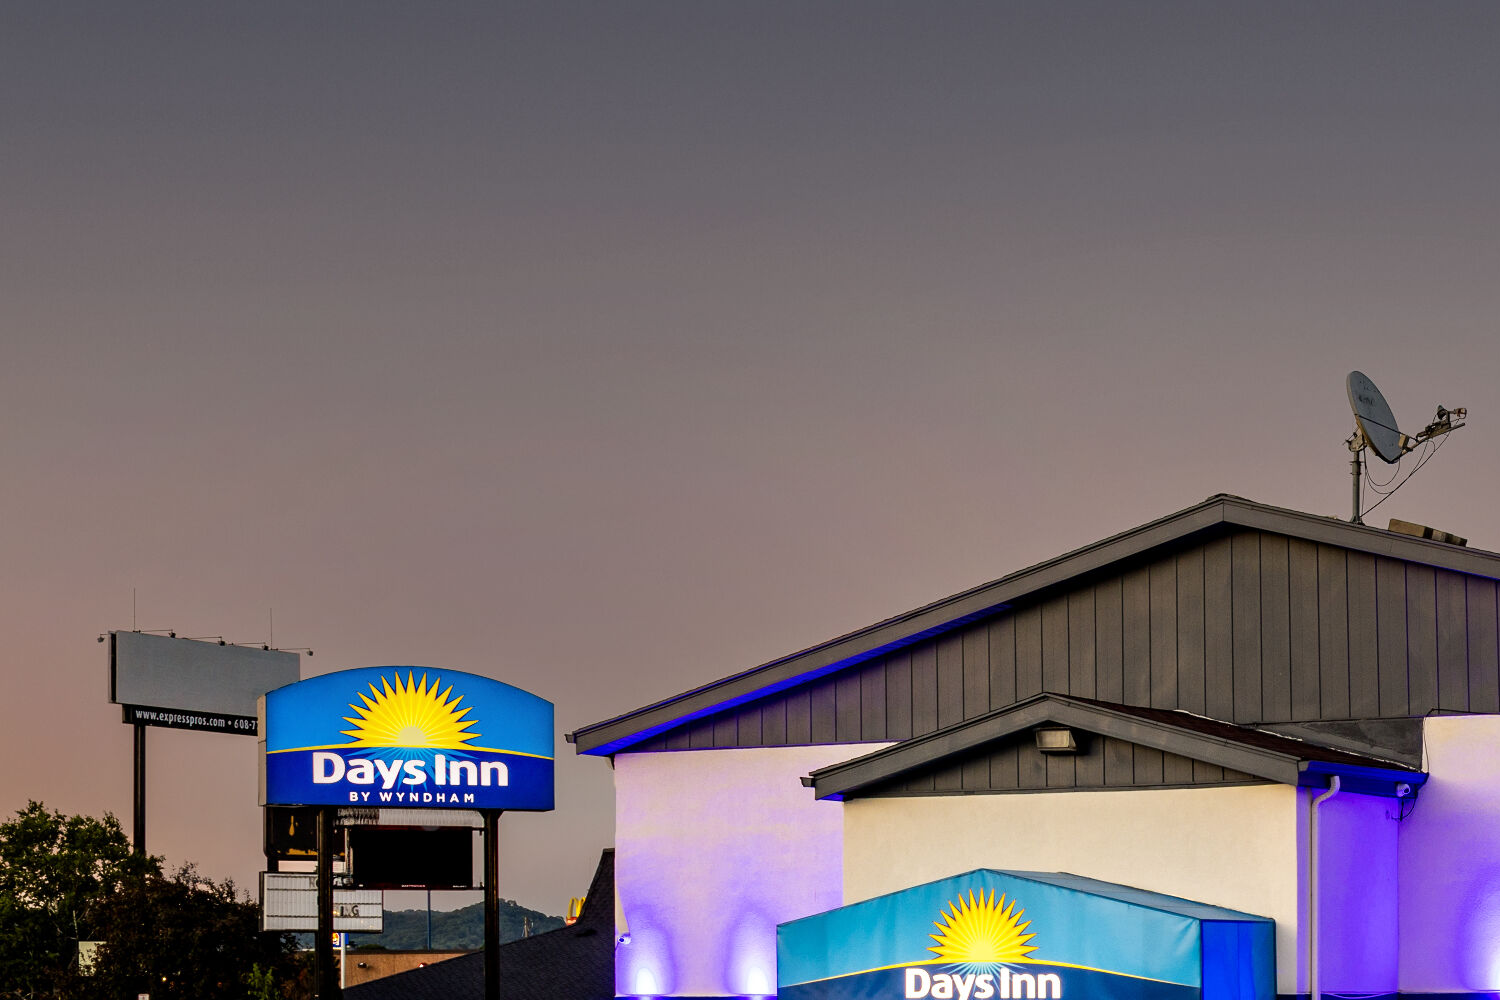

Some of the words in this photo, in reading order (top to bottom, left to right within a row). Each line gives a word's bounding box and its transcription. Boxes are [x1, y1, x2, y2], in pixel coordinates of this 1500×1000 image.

[136, 710, 225, 727] www.expresspros.com
[234, 719, 258, 730] 608-7
[312, 752, 427, 789] Days
[434, 754, 509, 787] Inn
[349, 791, 371, 802] BY
[379, 792, 475, 803] WYNDHAM
[1000, 967, 1061, 999] Inn
